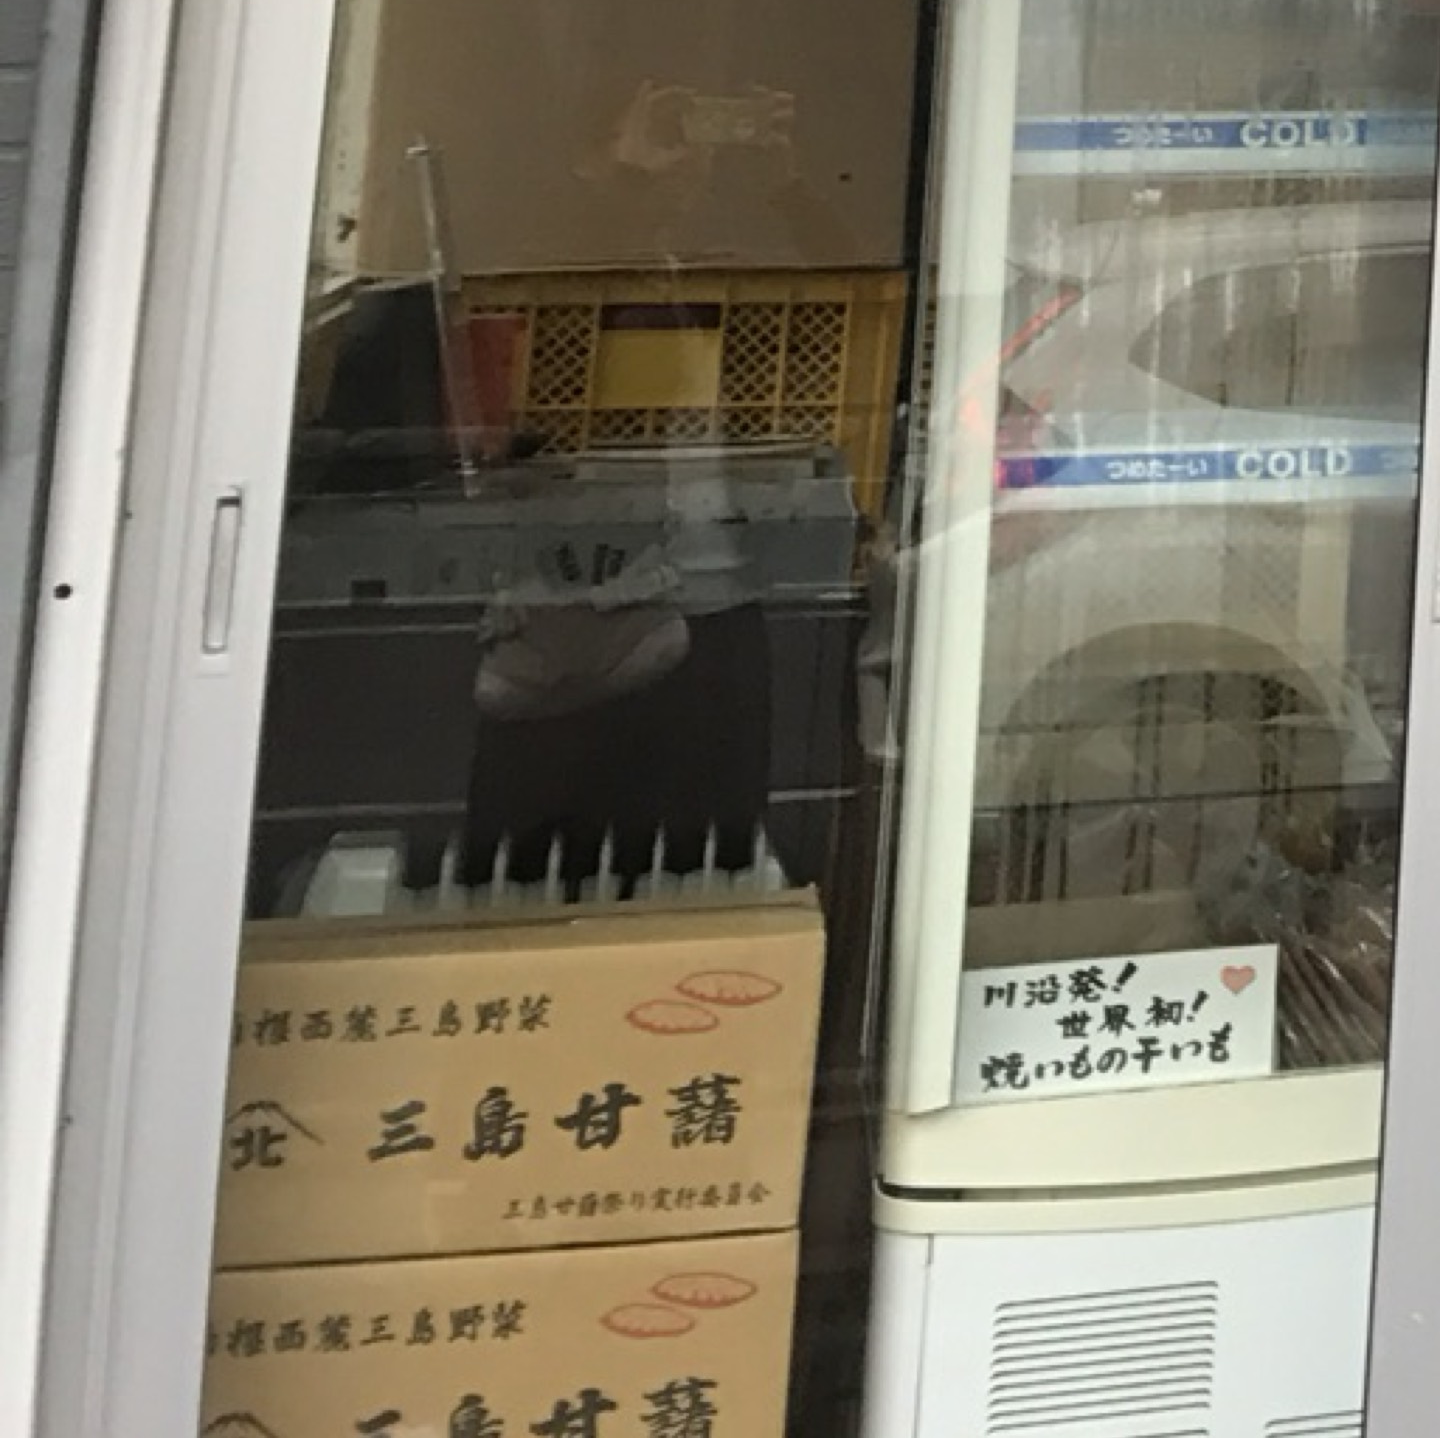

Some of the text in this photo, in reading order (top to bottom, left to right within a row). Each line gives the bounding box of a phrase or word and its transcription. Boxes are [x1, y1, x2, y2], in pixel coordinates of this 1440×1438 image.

[1239, 118, 1358, 148] COLD
[1234, 446, 1354, 479] COLD
[983, 961, 1138, 1009] 川沿発!
[1055, 990, 1210, 1040] 世界初!
[979, 1021, 1233, 1093] 焼いもの干いも
[229, 1127, 288, 1172] 北
